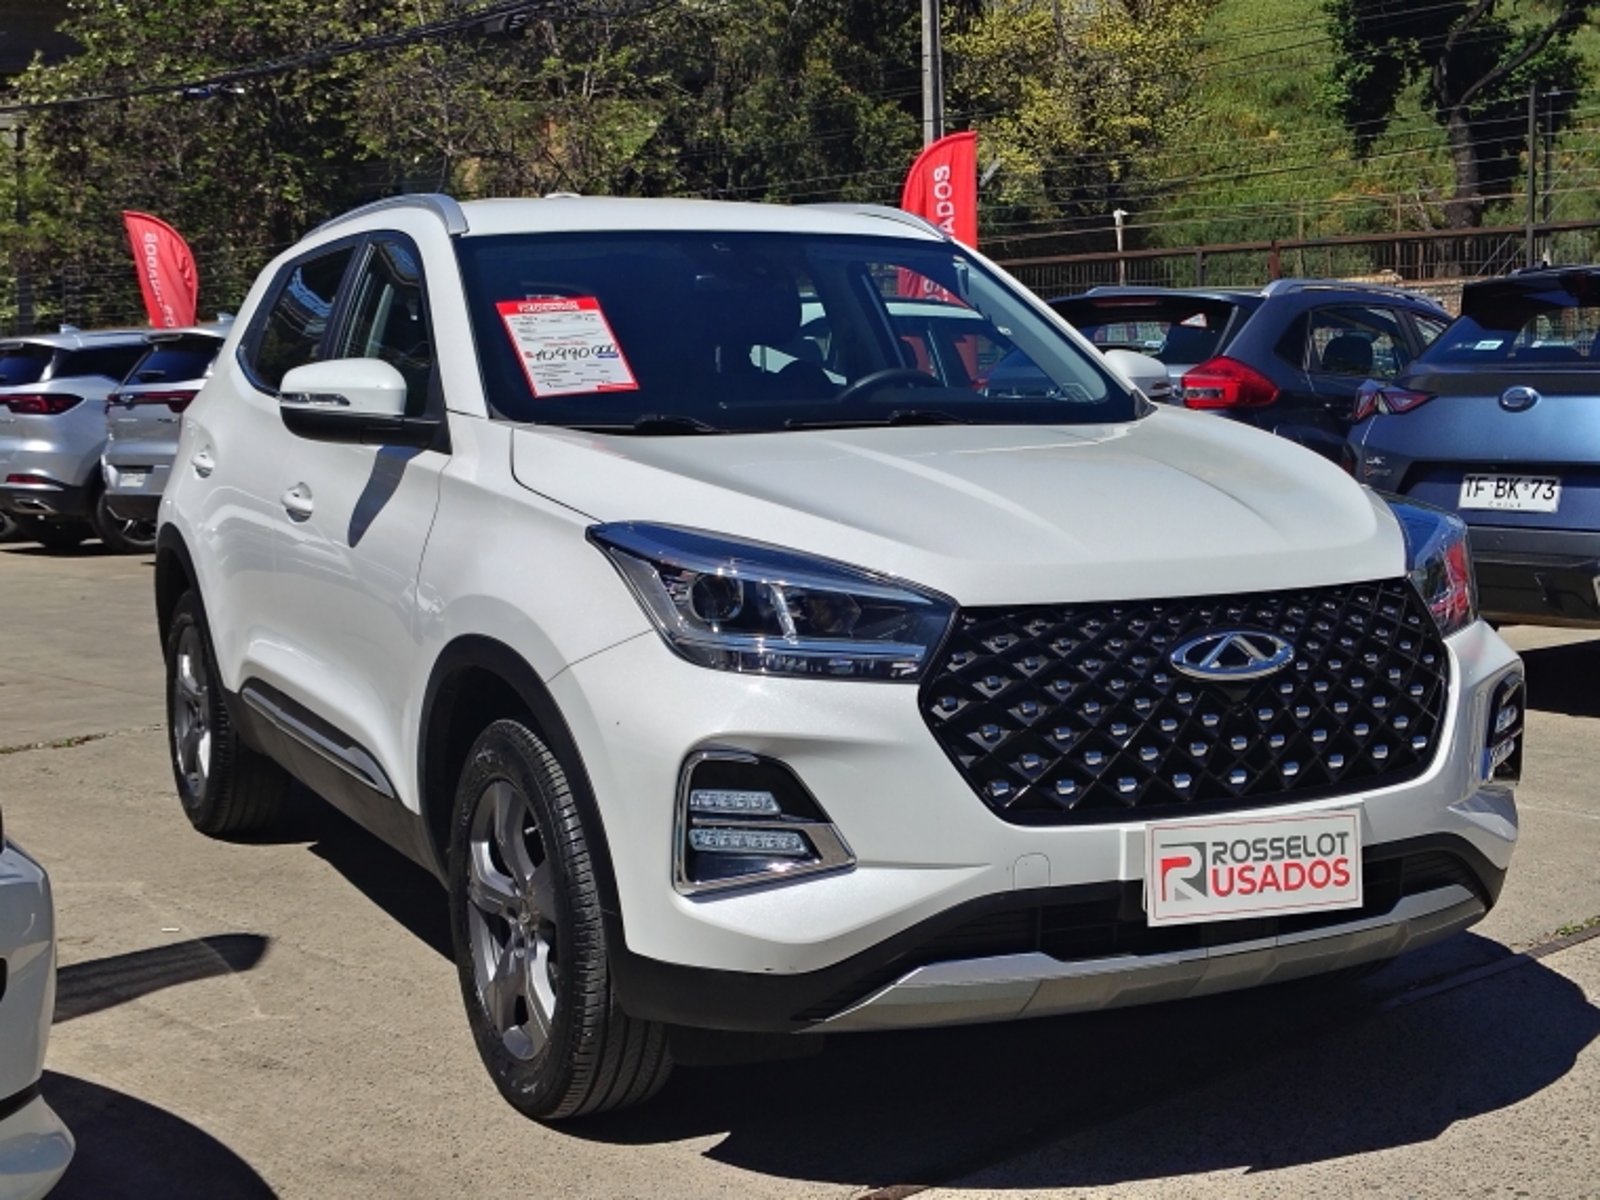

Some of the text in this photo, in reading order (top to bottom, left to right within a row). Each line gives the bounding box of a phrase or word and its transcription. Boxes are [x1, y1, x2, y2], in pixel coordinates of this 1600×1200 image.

[933, 164, 956, 240] ADOS
[1211, 831, 1350, 866] ROSSELOT
[1211, 858, 1351, 898] USADOS
